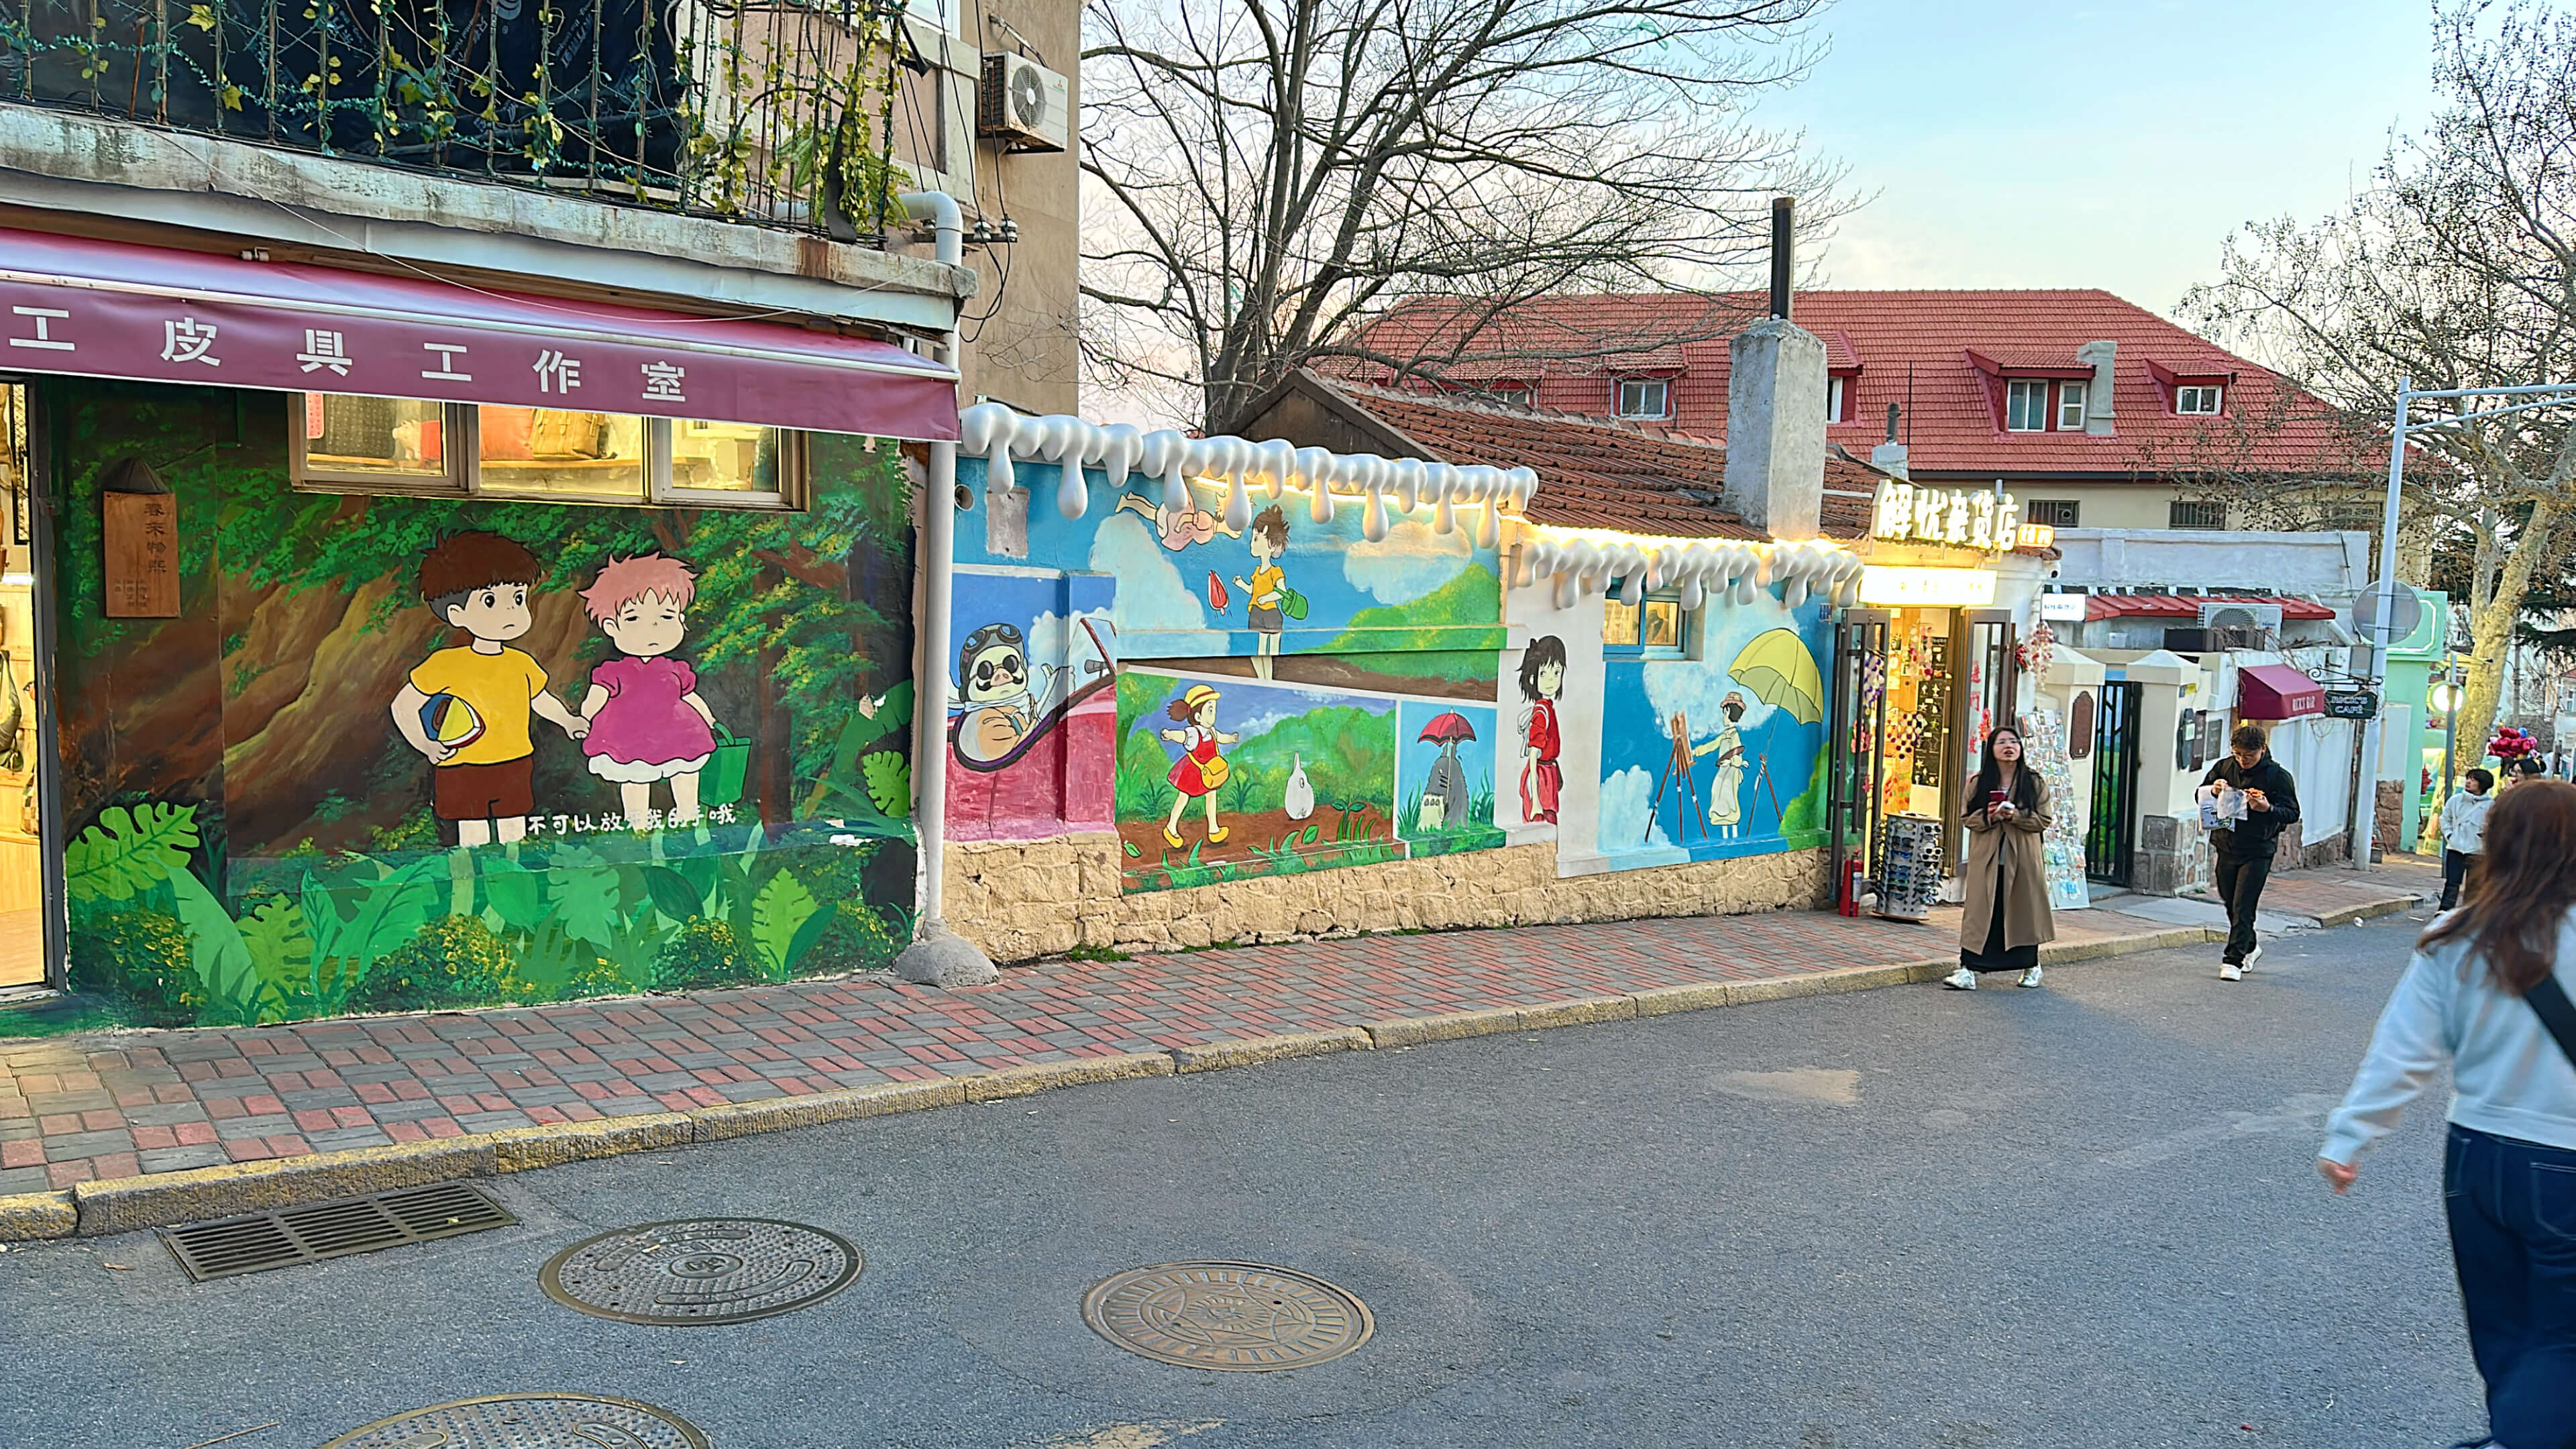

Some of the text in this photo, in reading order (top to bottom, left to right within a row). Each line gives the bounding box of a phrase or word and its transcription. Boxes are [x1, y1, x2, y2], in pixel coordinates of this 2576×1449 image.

[9, 306, 686, 402] 工皮具工作室
